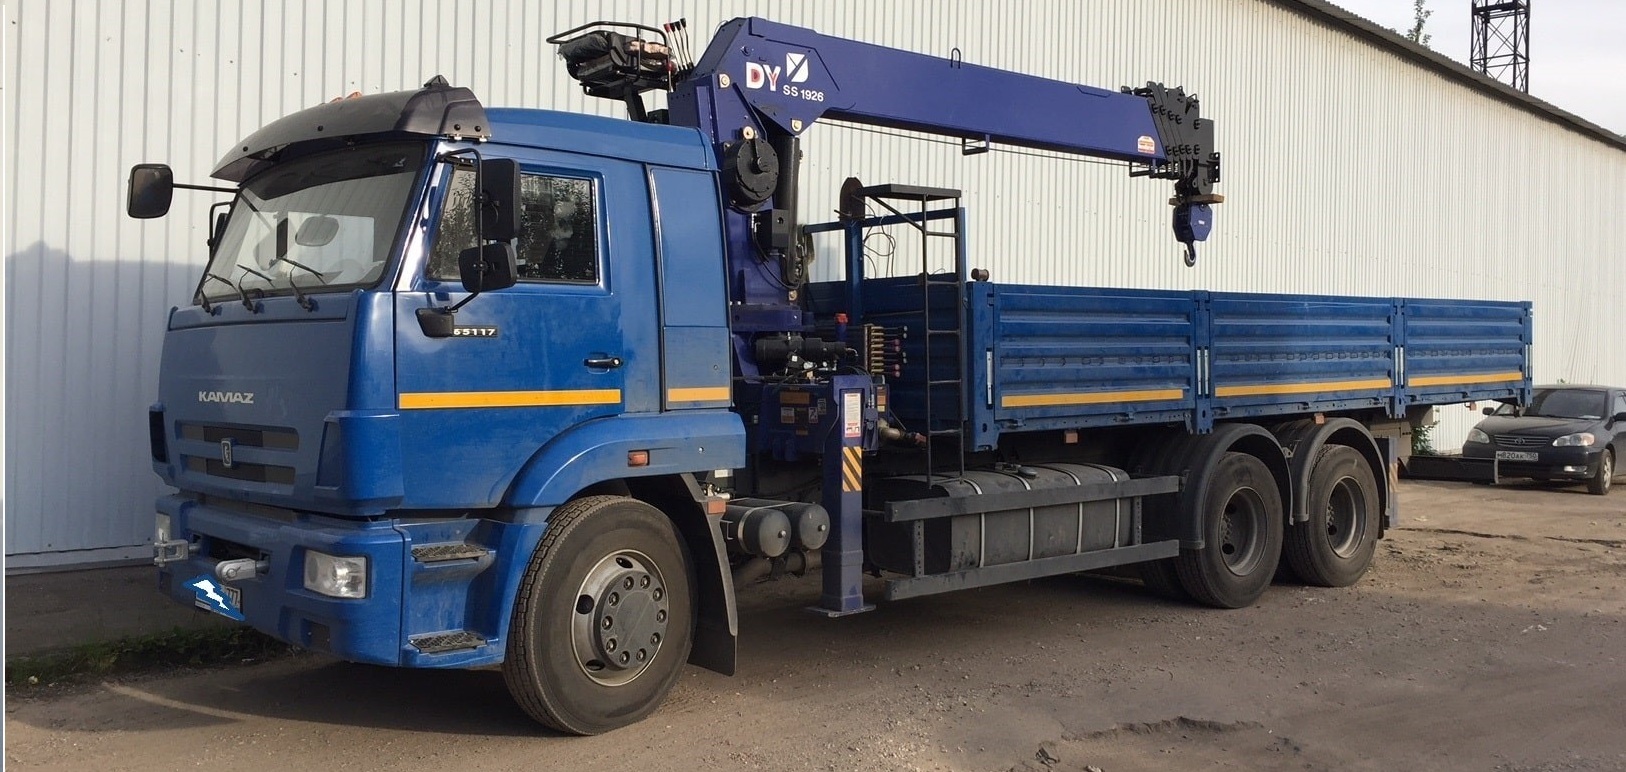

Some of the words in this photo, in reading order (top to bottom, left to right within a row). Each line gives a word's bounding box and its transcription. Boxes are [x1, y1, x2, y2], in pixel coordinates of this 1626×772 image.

[746, 61, 781, 92] DY
[782, 84, 799, 97] SS
[800, 89, 824, 102] 1926
[198, 391, 254, 404] KAMAZ
